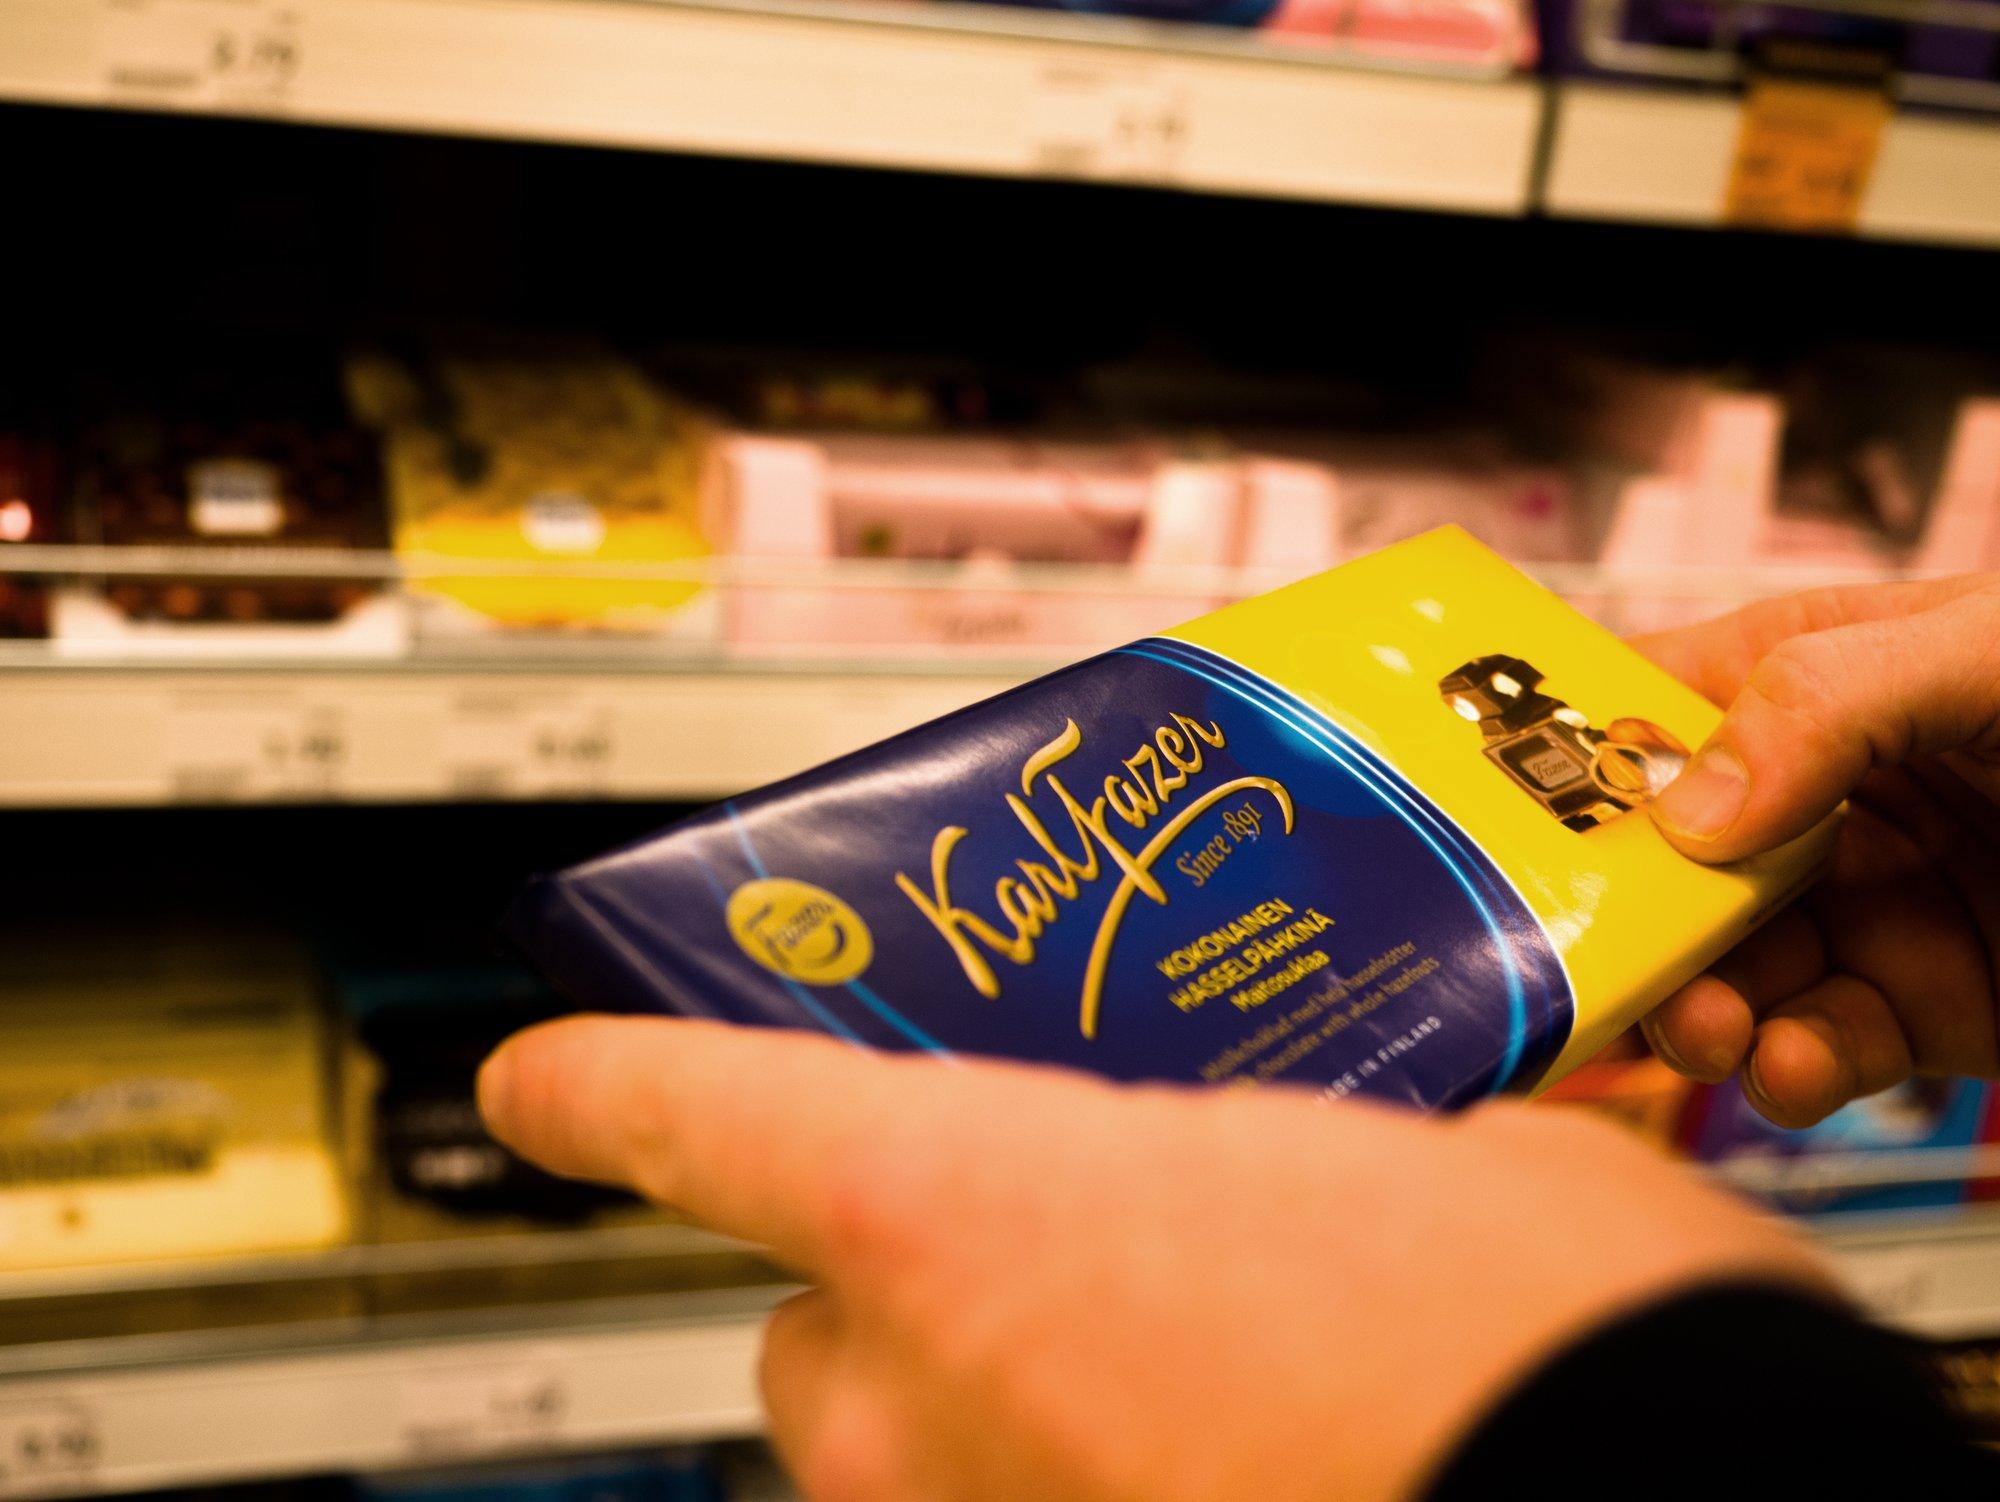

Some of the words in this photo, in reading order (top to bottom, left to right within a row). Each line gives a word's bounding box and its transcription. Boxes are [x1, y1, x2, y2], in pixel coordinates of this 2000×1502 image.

[1175, 834, 1232, 887] Since
[1222, 802, 1262, 843] 1891
[894, 792, 1099, 1000] Karl
[1155, 896, 1294, 981] KOKONAINEN
[1168, 907, 1336, 1014] HASSELPÄHKINÄ
[1229, 950, 1332, 1013] Maitosuklaa
[1356, 1056, 1382, 1079] IN
[1376, 1014, 1443, 1065] FINLAND
